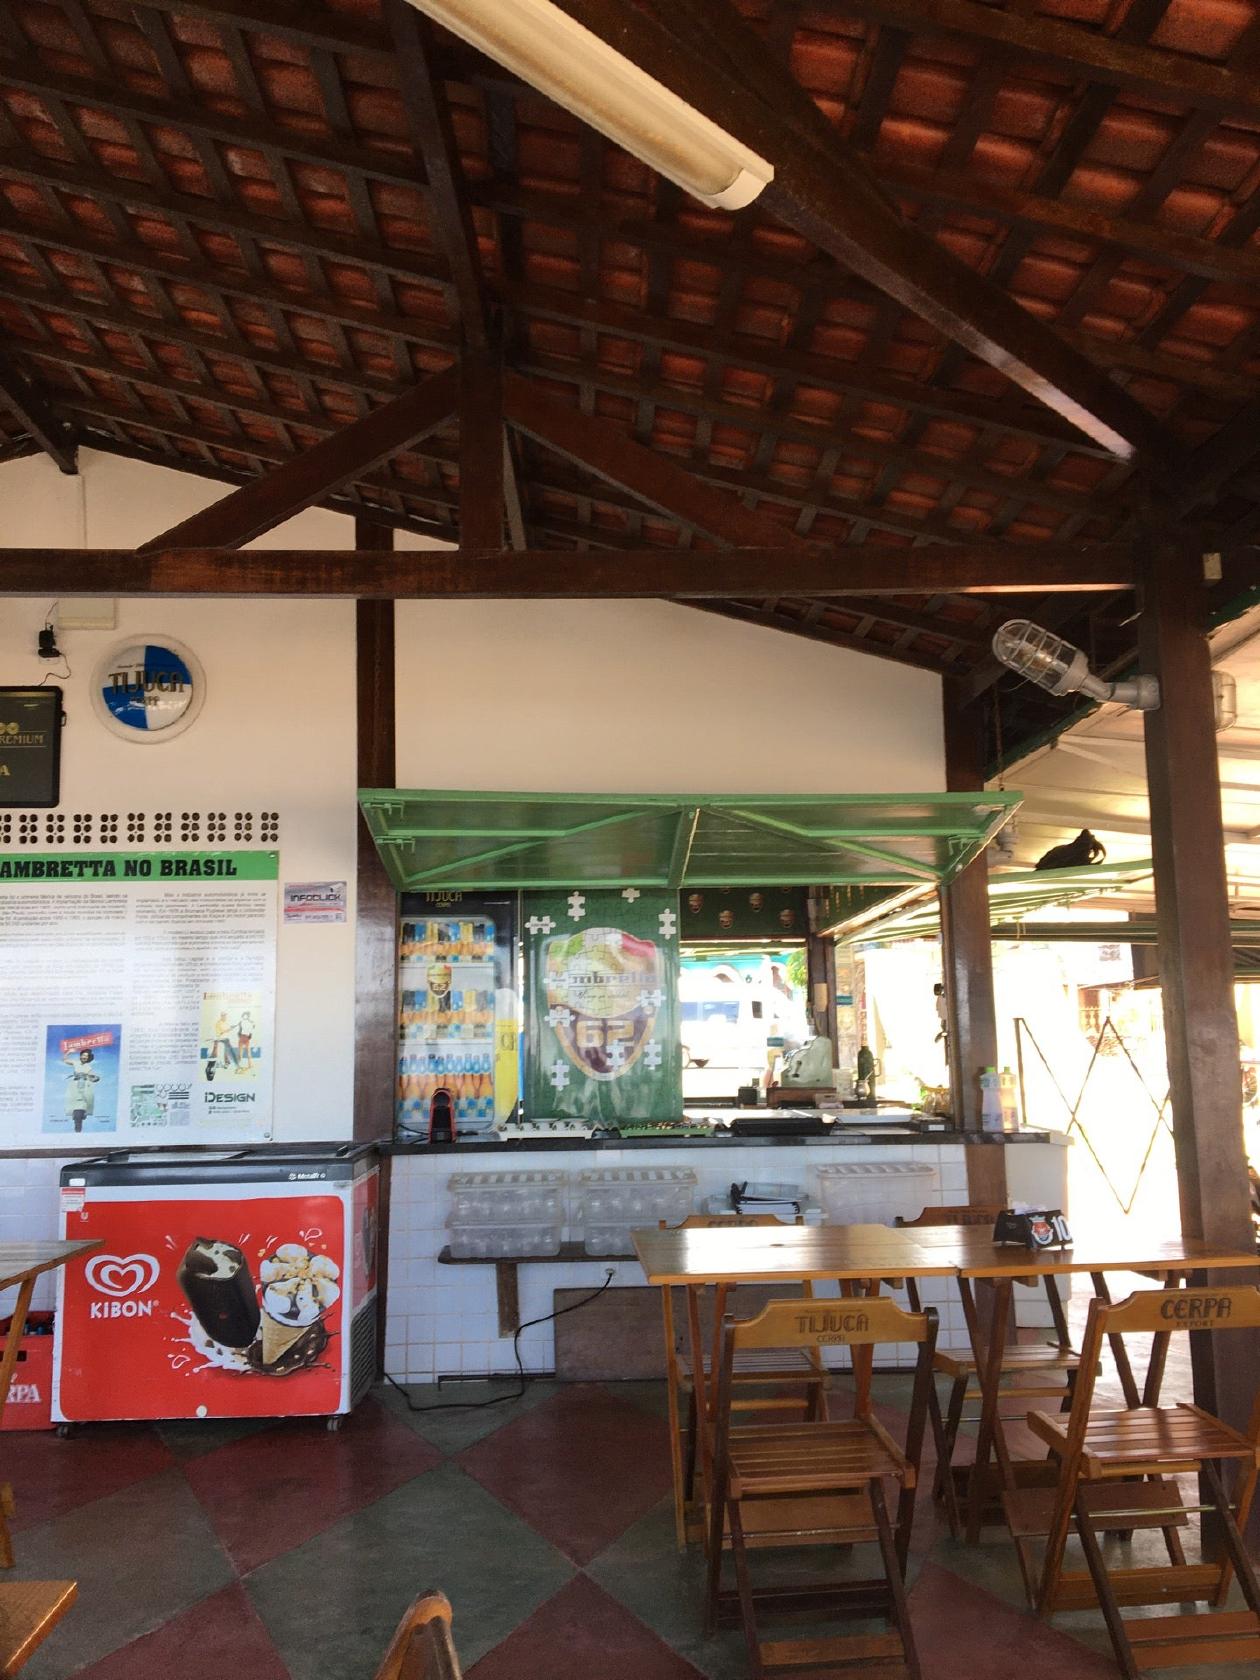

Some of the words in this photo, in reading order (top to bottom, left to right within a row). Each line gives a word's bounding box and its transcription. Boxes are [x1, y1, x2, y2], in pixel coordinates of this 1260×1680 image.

[108, 671, 184, 694] TIJUCA
[123, 859, 152, 877] NO
[160, 859, 237, 876] BRASIL
[576, 1020, 634, 1048] 62
[90, 1300, 152, 1319] KIBON
[1160, 1297, 1232, 1319] CERPA
[794, 1312, 869, 1333] TIJUCA
[6, 1384, 42, 1403] RPA
